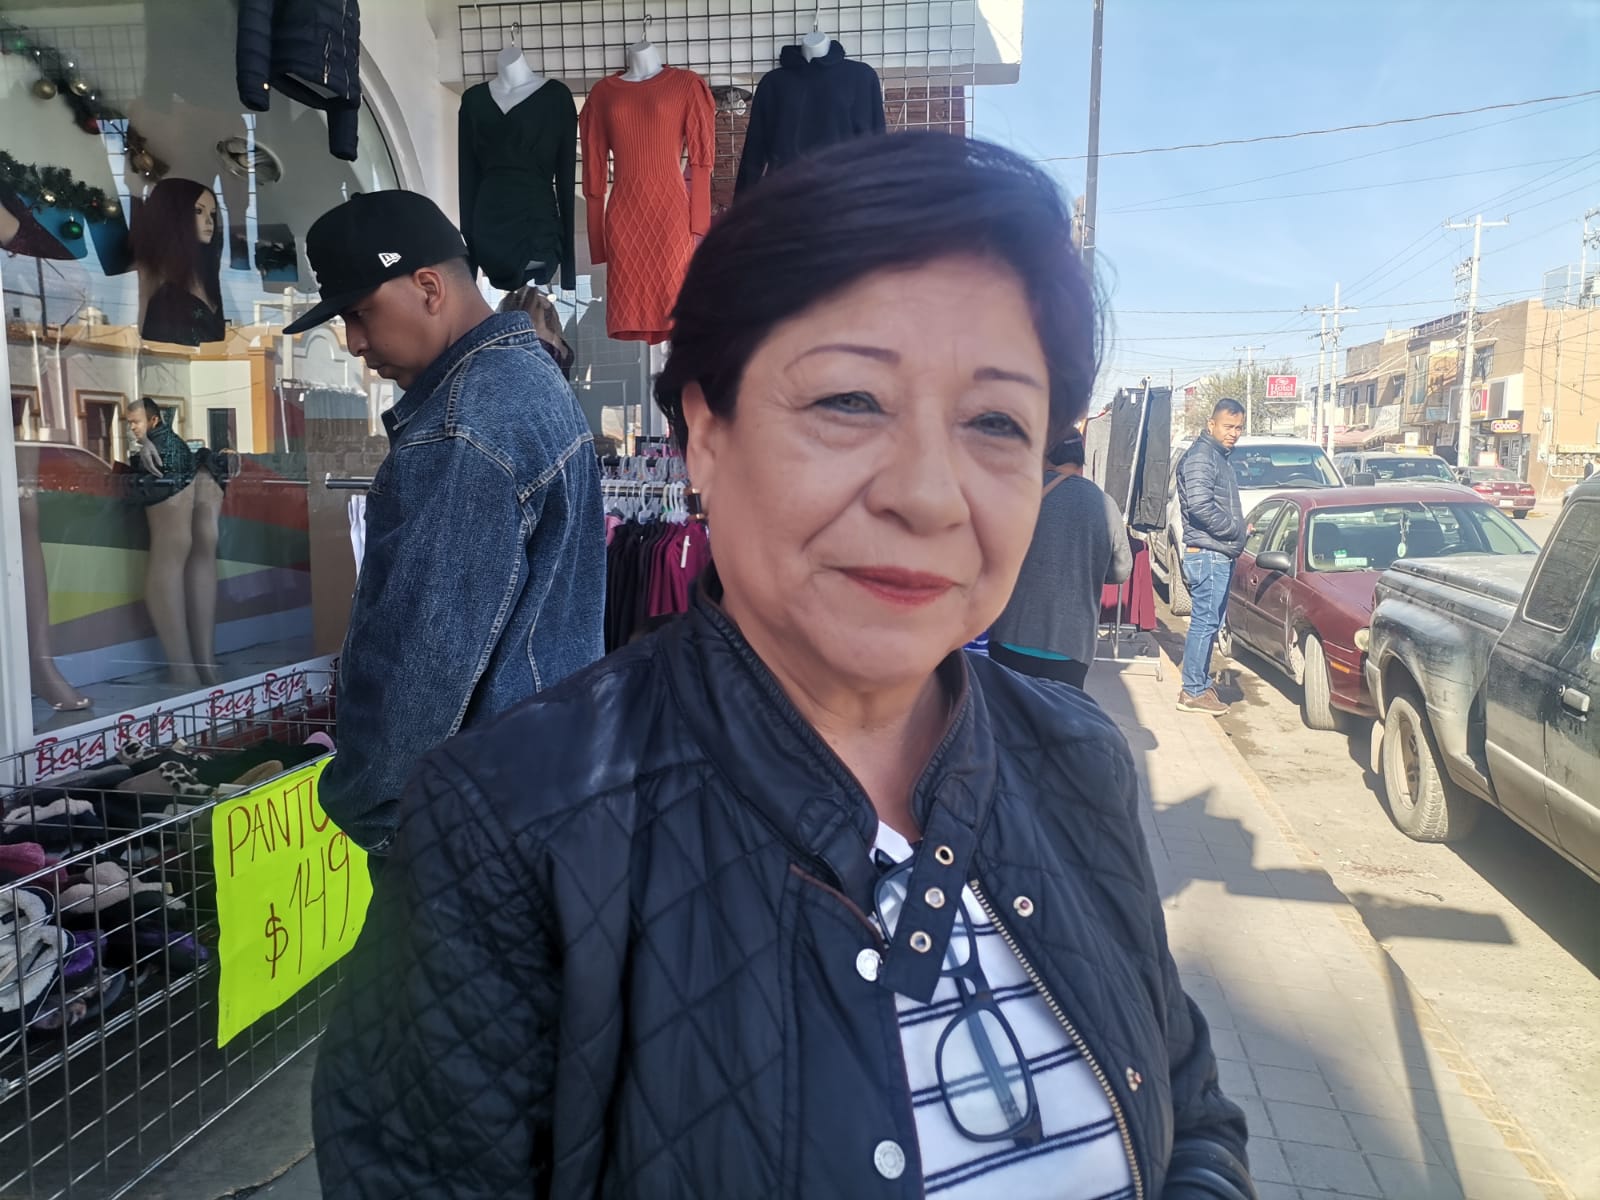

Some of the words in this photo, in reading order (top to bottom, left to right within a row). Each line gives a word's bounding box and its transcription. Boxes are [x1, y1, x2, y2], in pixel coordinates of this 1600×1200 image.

[1270, 383, 1294, 392] Hotel
[35, 737, 105, 780] Boca
[114, 706, 175, 751] Roa
[265, 831, 350, 979] $149
